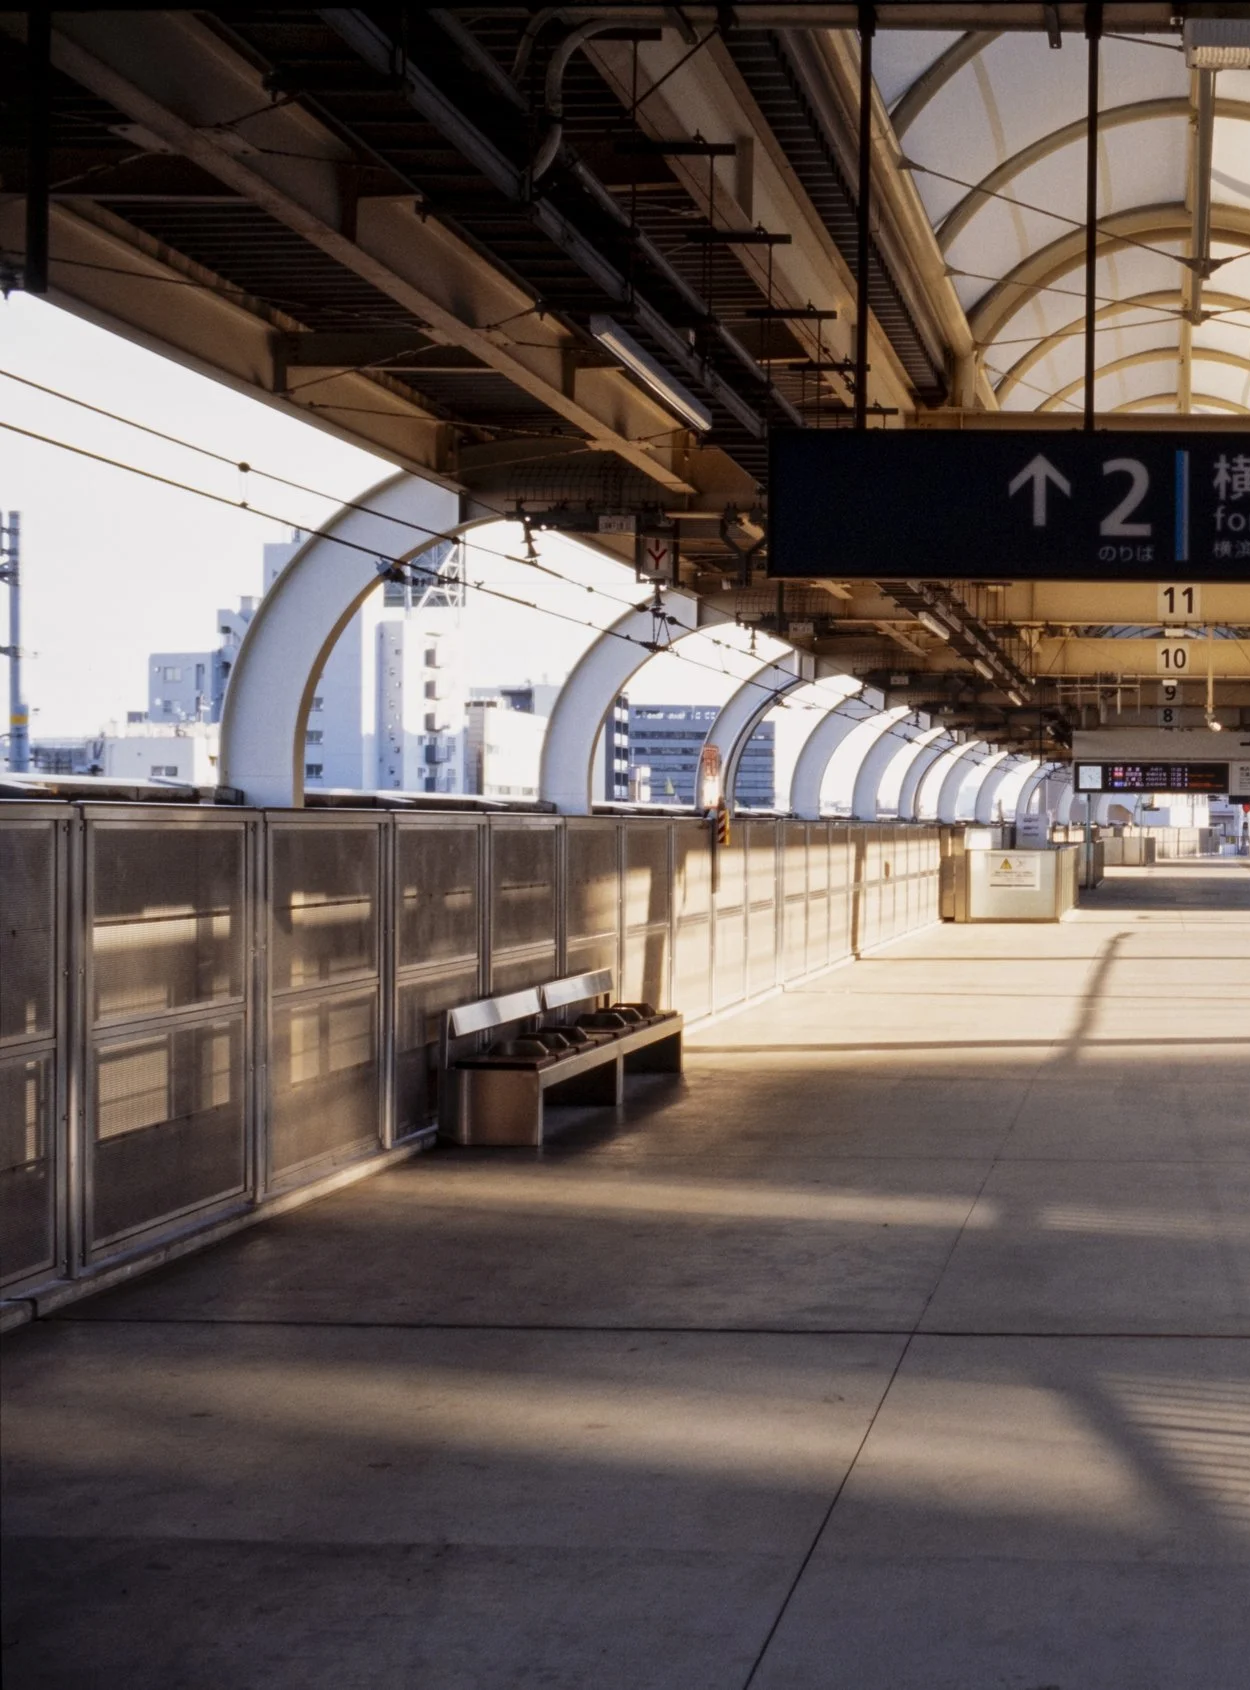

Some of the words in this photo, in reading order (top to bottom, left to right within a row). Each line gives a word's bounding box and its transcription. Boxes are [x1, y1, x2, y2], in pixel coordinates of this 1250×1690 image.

[1100, 457, 1152, 537] 2
[1098, 545, 1154, 561] のりば
[1163, 586, 1193, 614] 11
[1160, 648, 1186, 669] 10
[1165, 686, 1176, 700] 9
[1163, 708, 1173, 722] 8
